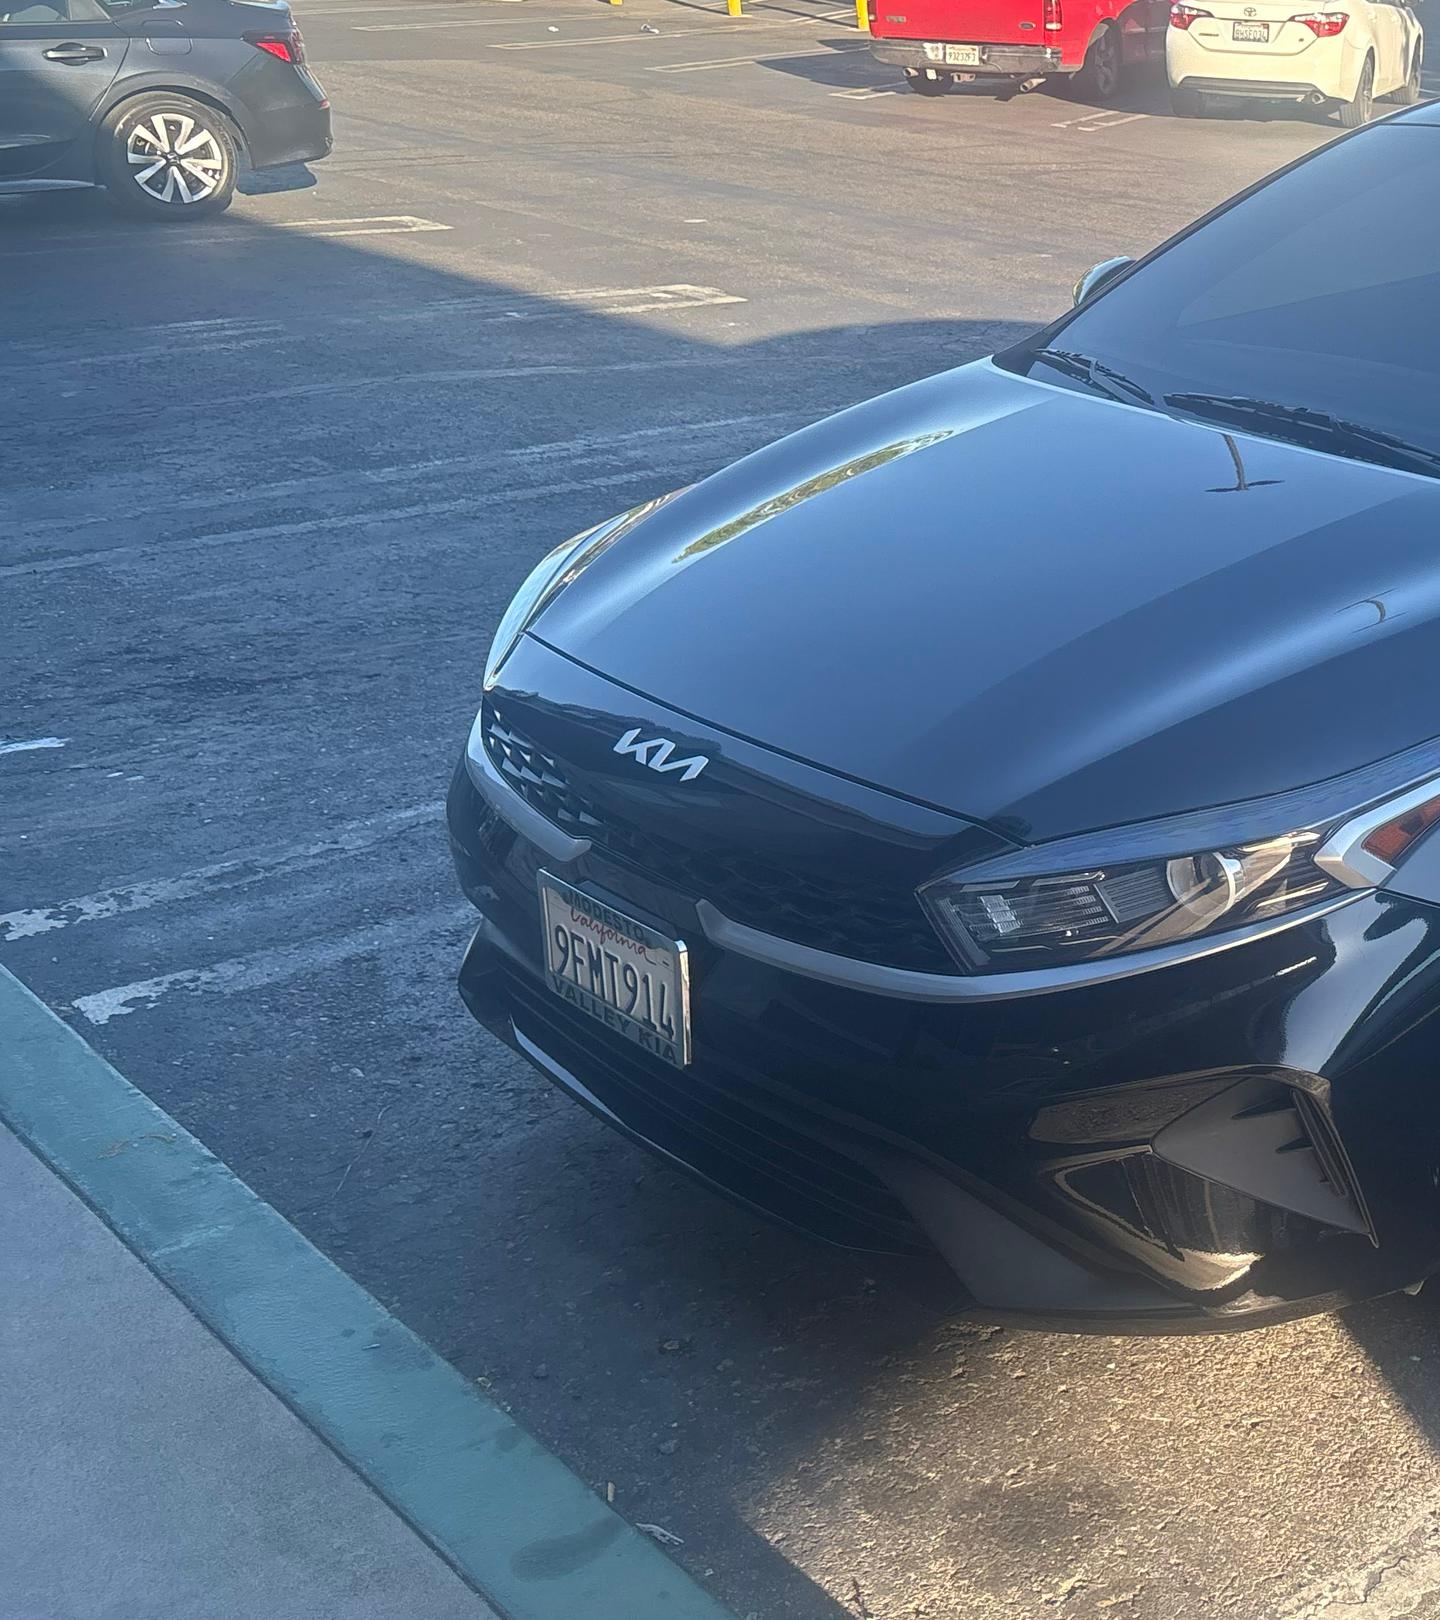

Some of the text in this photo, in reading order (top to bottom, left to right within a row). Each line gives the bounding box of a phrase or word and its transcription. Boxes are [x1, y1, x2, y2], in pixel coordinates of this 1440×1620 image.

[613, 728, 709, 781] KIA
[570, 891, 646, 940] MODESTO
[570, 907, 657, 965] California
[555, 924, 676, 1039] 9FMT914
[554, 975, 677, 1064] VALLEY KIA
